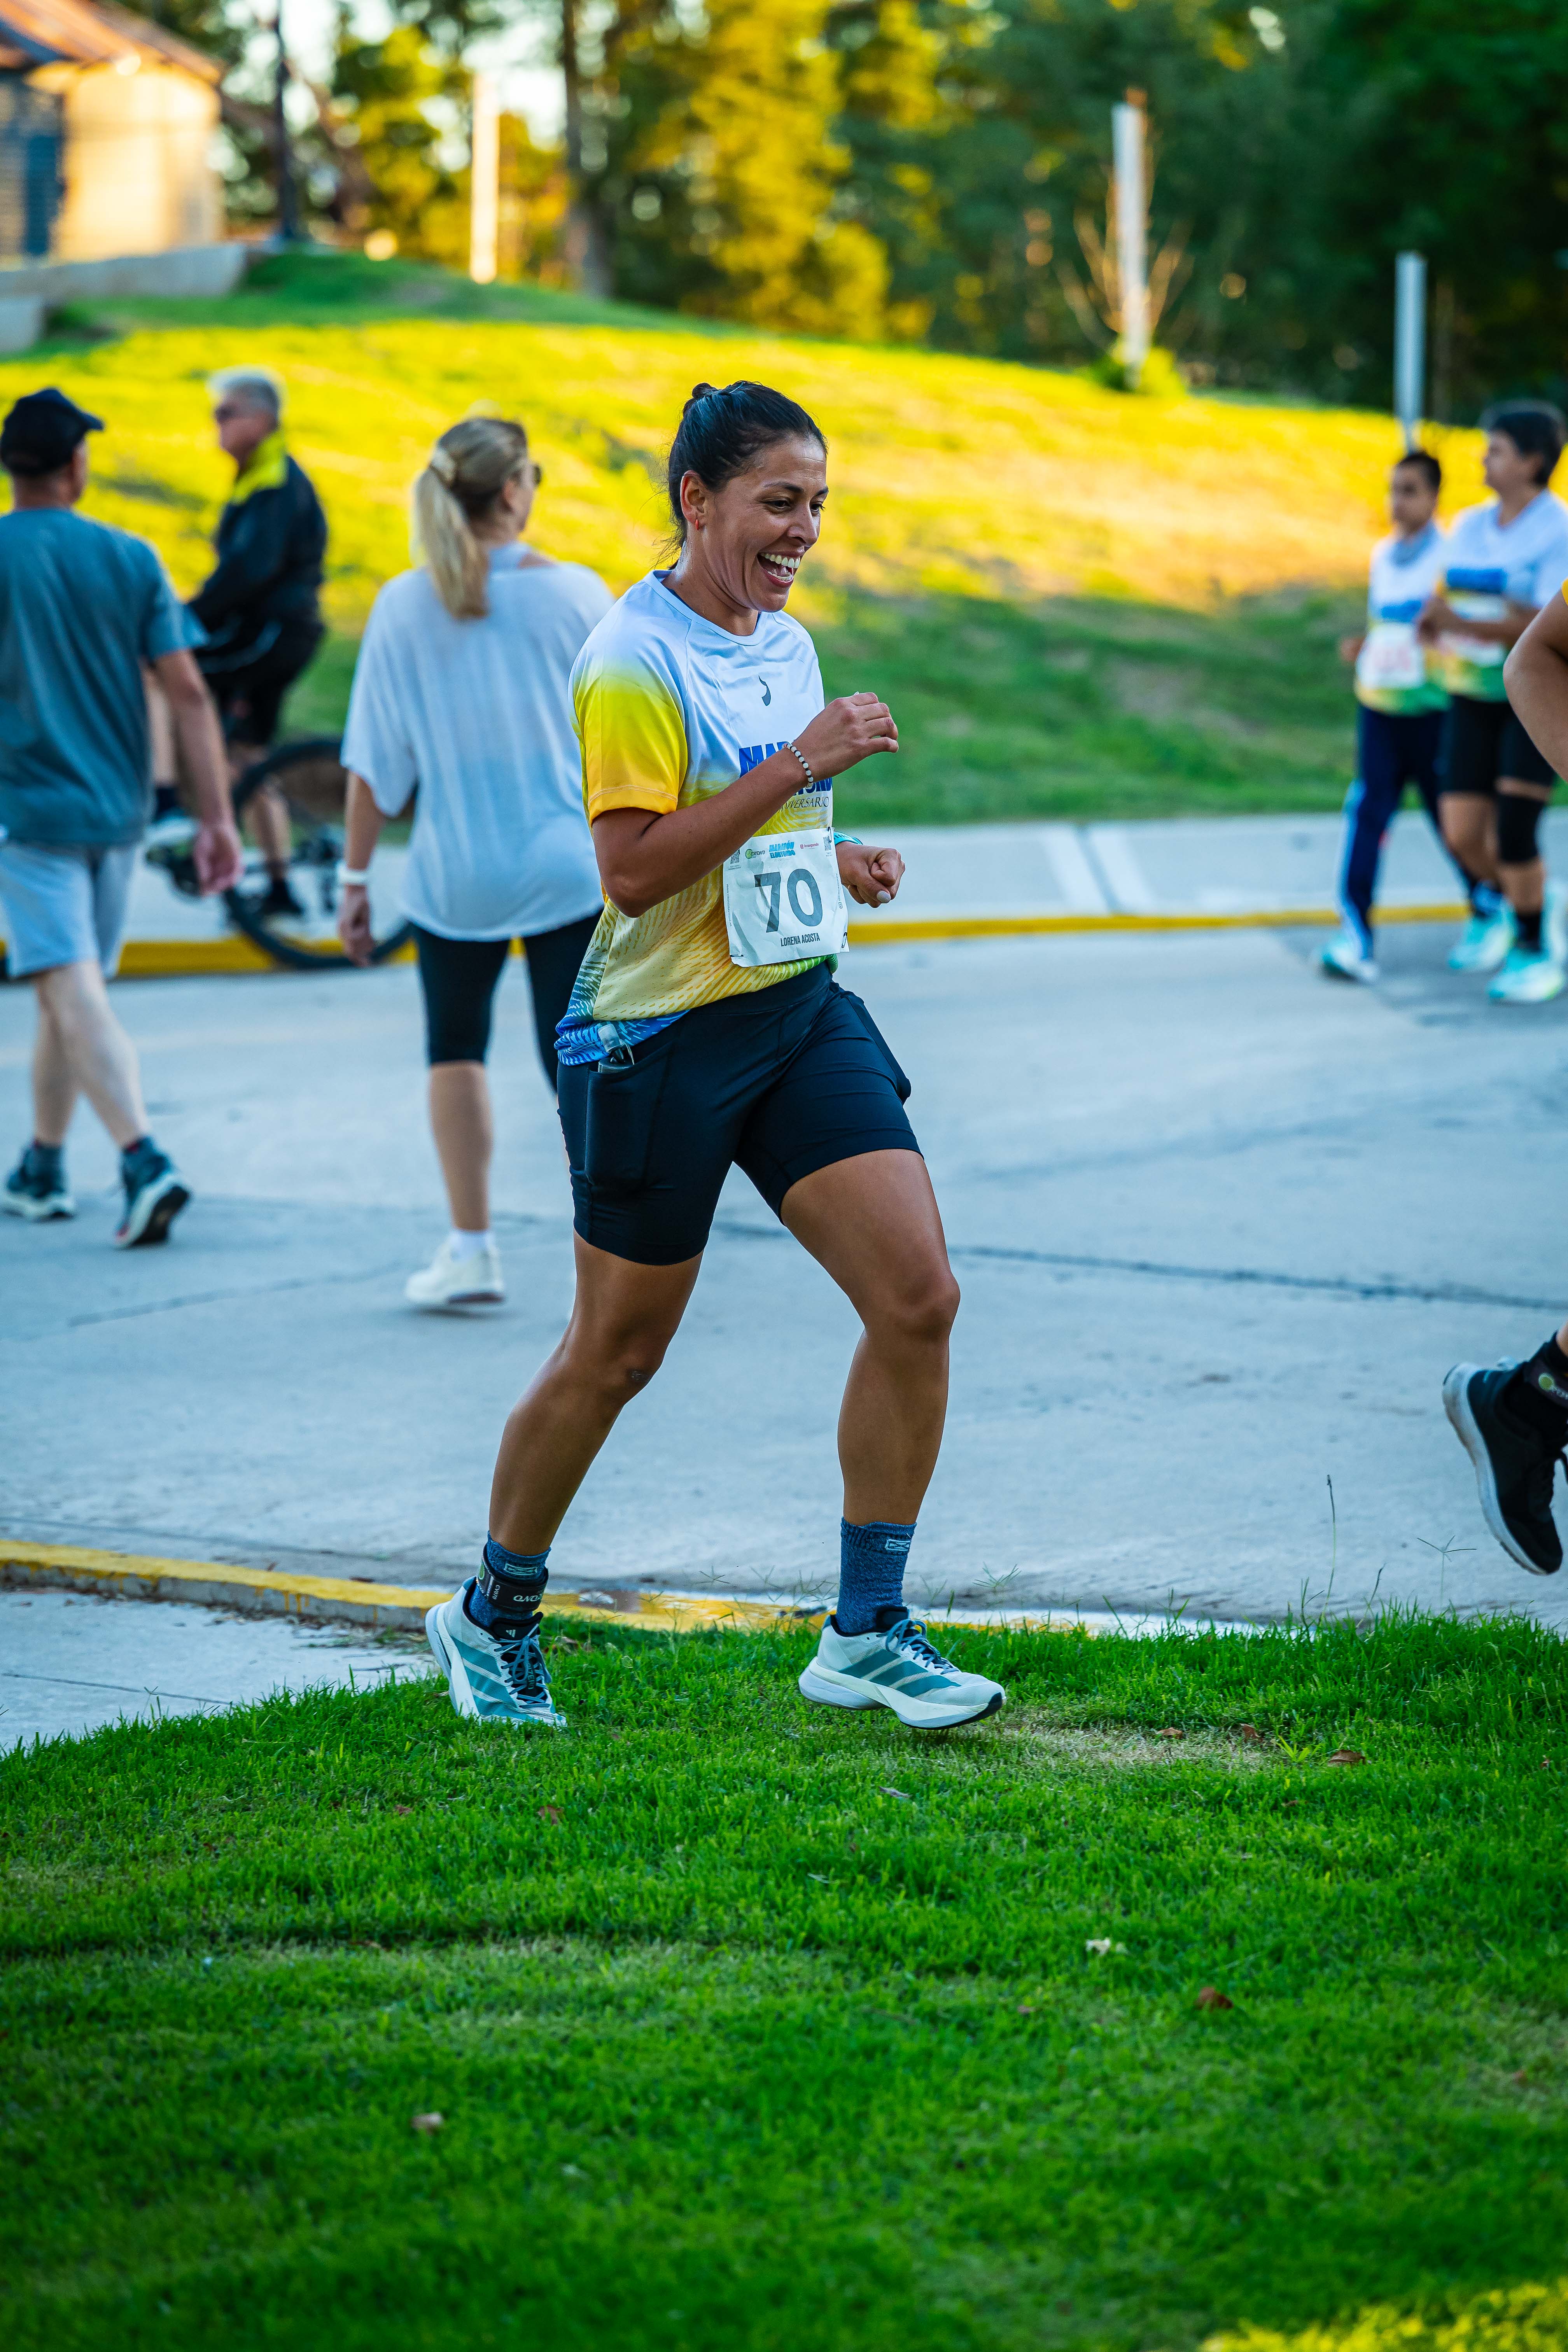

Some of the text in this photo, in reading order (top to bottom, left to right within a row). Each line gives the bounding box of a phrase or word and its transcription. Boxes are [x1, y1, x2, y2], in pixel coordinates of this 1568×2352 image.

[769, 840, 794, 852] MARATÓN
[754, 868, 823, 933] 70
[780, 933, 821, 947] LORENA ACOSTA
[492, 1585, 500, 1600] CV070
